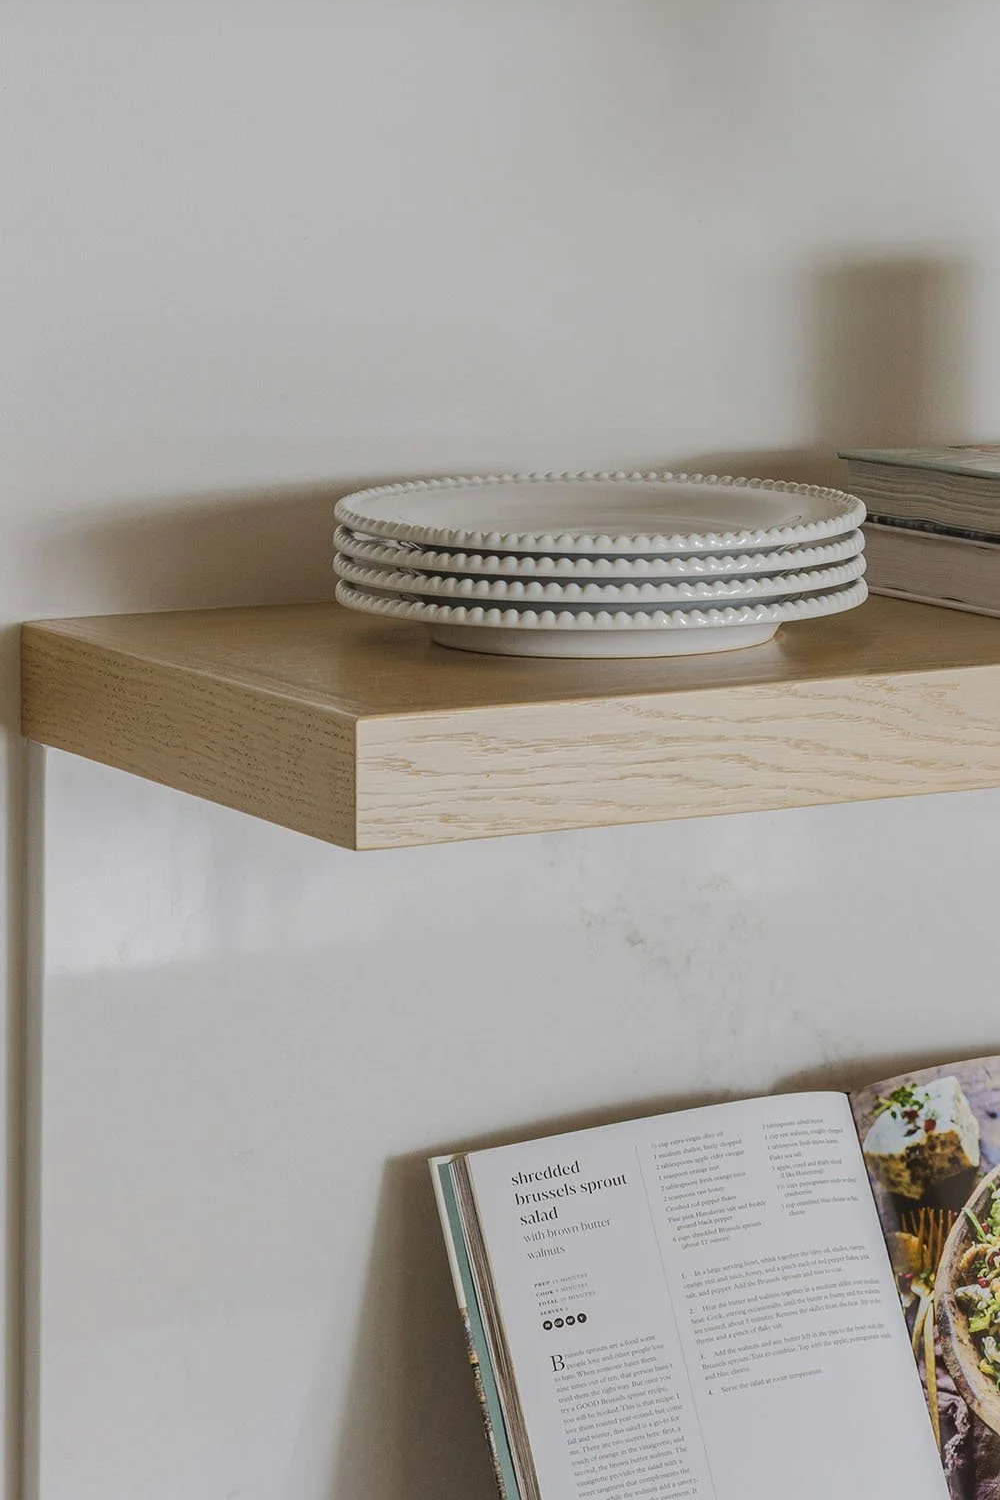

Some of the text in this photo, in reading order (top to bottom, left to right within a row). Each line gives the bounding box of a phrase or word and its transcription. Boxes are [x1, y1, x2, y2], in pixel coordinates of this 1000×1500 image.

[719, 1138, 742, 1147] chopped
[511, 1160, 580, 1186] shredded
[514, 1174, 627, 1205] brussels sprout
[665, 1203, 690, 1212] Crushed
[690, 1200, 700, 1208] red
[700, 1198, 720, 1207] pepper
[520, 1206, 558, 1225] salad
[697, 1218, 713, 1226] black
[713, 1215, 733, 1224] pepper
[523, 1218, 610, 1243] with brown butter
[691, 1228, 717, 1238] shredded
[718, 1224, 741, 1233] Brussels
[527, 1245, 565, 1259] walnuts
[585, 1345, 608, 1355] sprouts
[624, 1337, 639, 1346] food
[566, 1359, 586, 1370] people
[601, 1353, 613, 1362] and
[630, 1346, 651, 1356] people
[576, 1369, 595, 1377] When
[596, 1363, 623, 1373] someone
[556, 1385, 569, 1393] nine
[632, 1367, 654, 1377] person
[573, 1392, 590, 1400] them
[659, 1374, 671, 1382] you
[575, 1400, 599, 1410] GOOD
